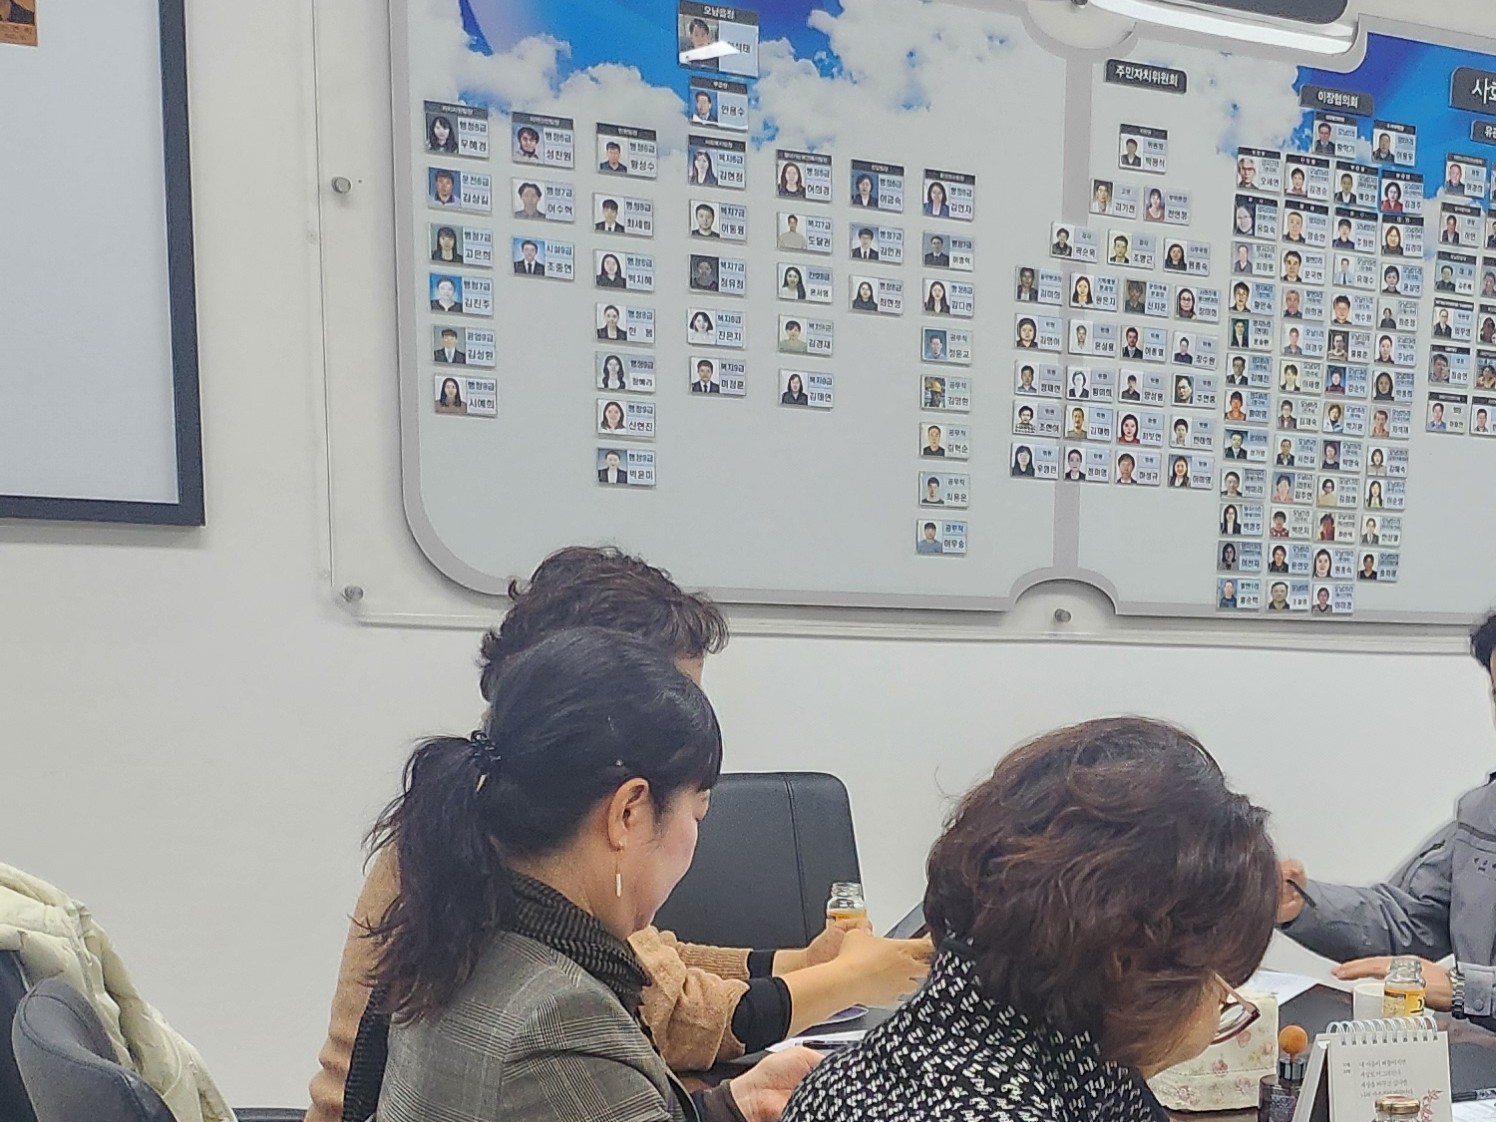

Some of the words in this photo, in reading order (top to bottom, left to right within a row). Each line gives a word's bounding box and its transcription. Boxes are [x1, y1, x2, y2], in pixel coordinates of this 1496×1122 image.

[704, 6, 735, 20] 오남읍장
[1116, 65, 1178, 87] 주민자치위원회
[1318, 90, 1359, 108] 이장협의회
